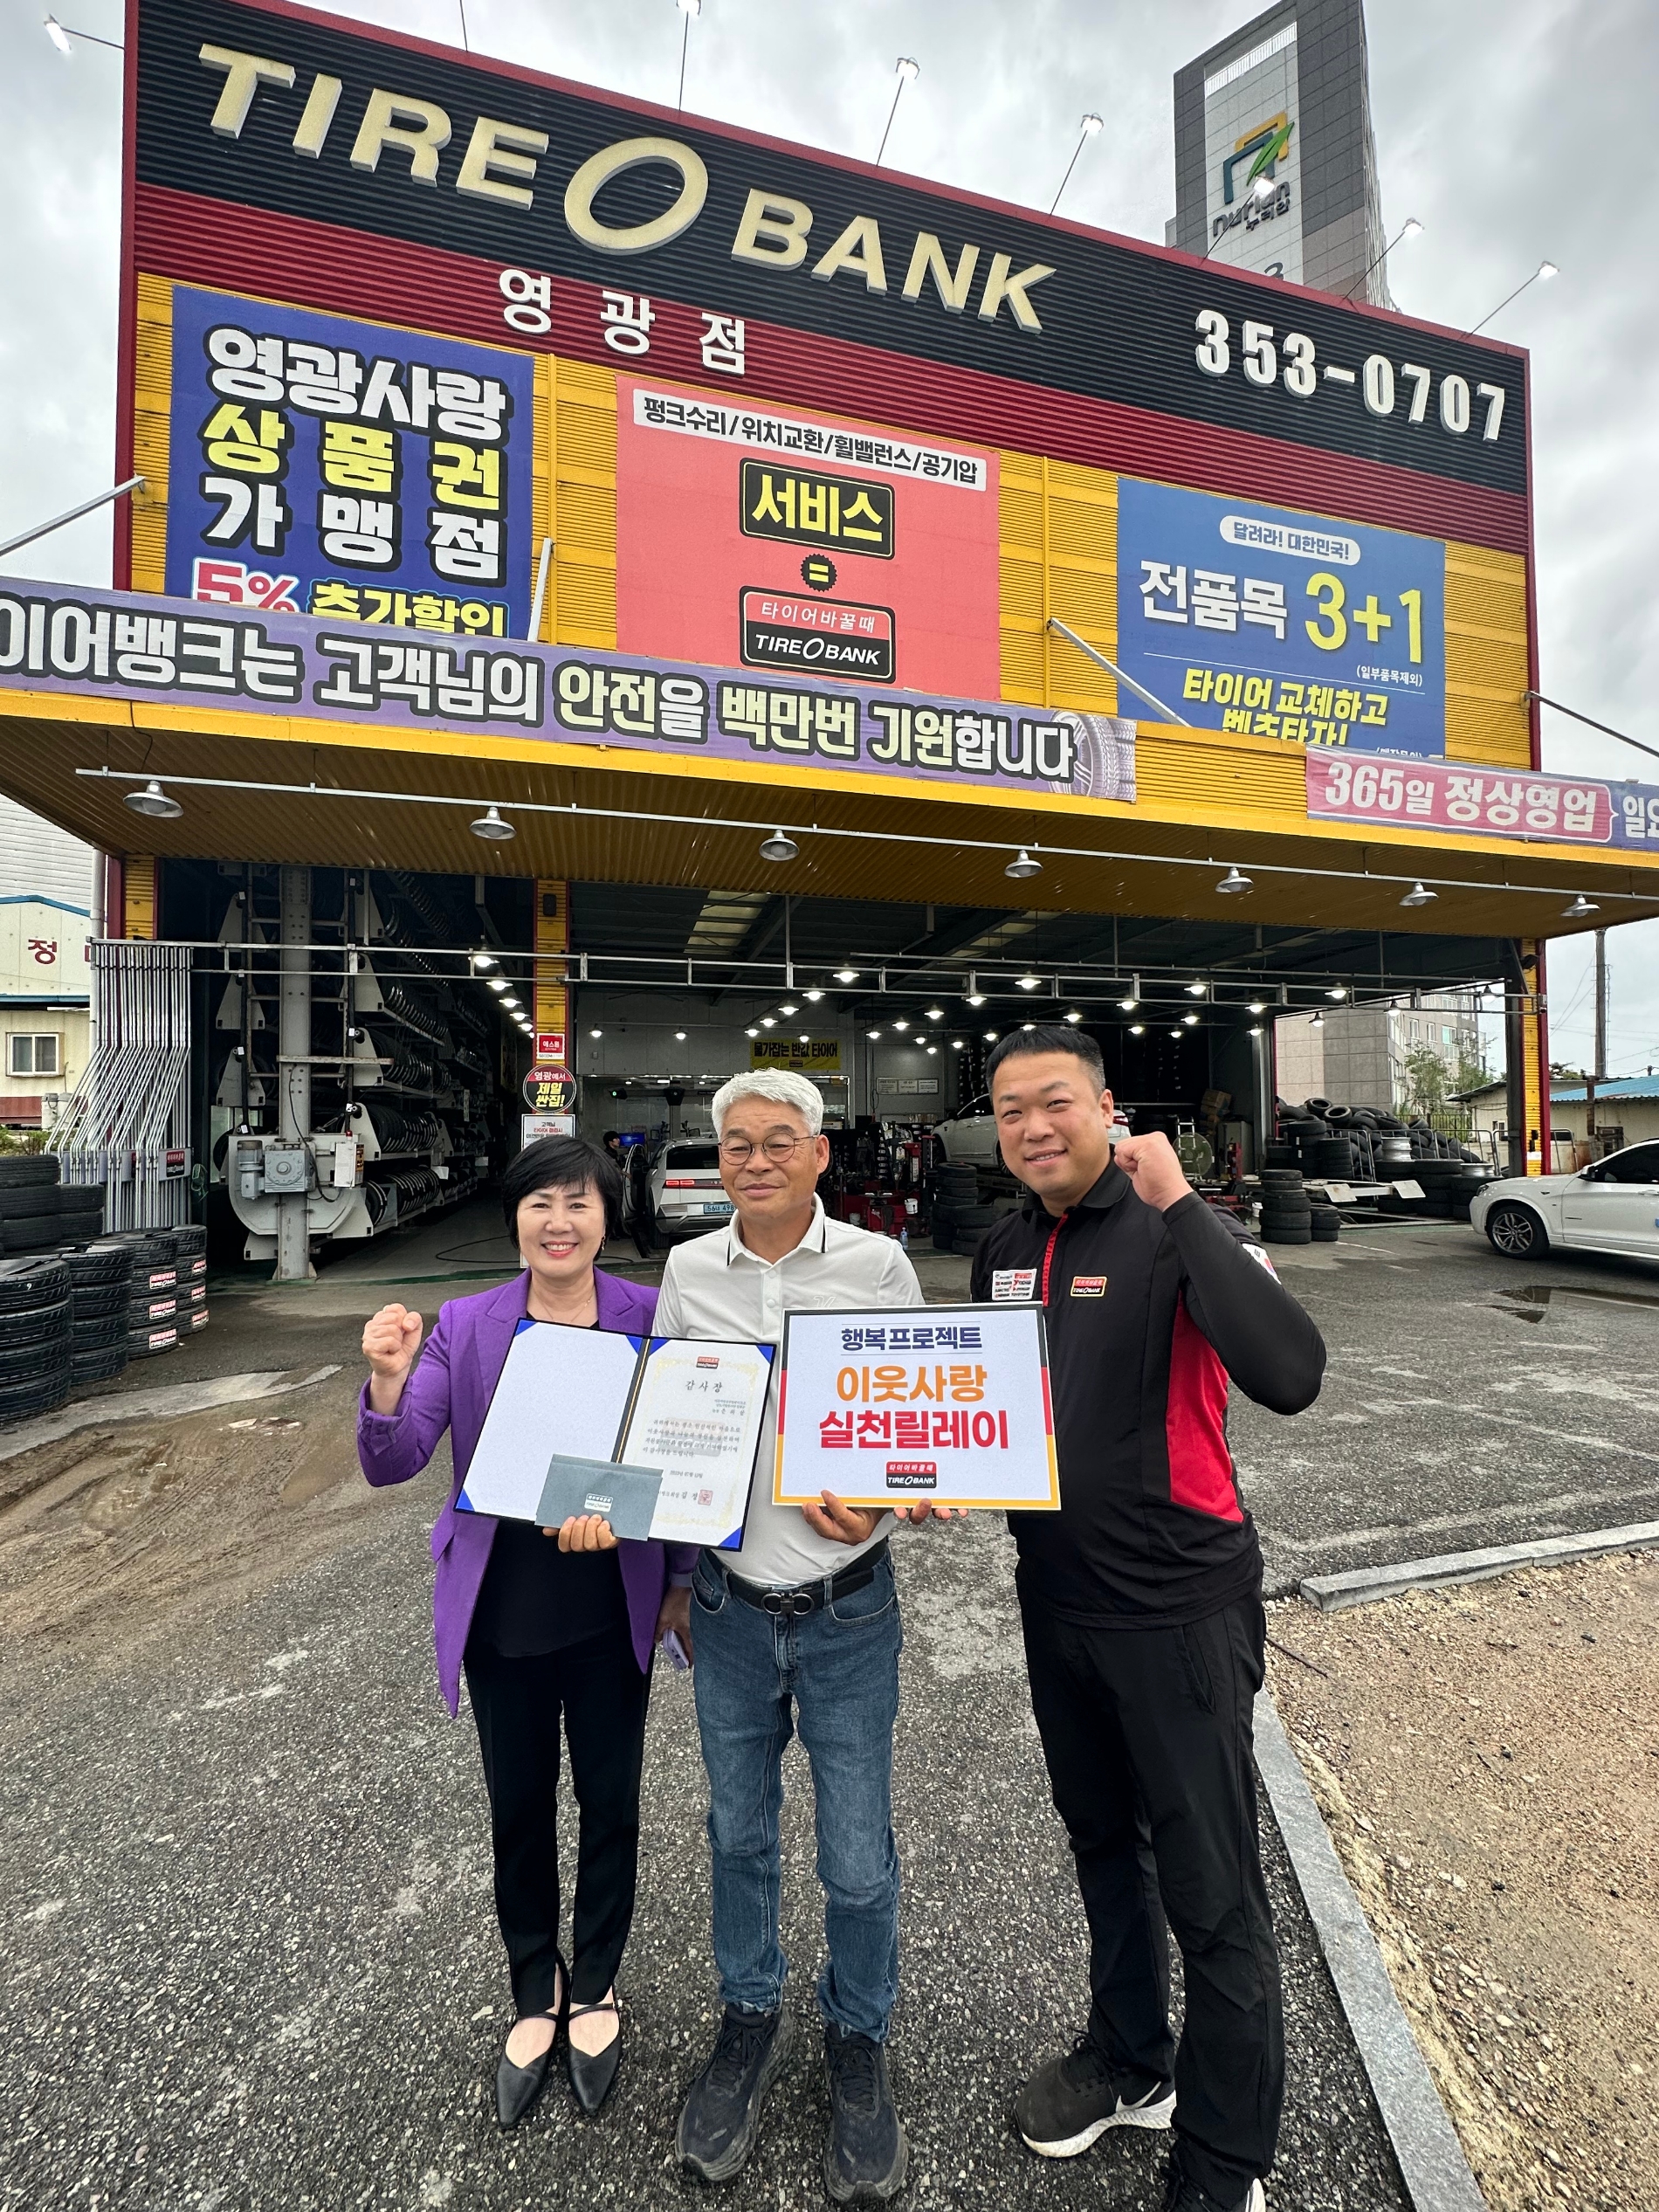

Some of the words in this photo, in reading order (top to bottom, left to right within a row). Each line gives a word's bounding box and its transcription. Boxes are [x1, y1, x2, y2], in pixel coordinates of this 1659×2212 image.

[209, 327, 506, 440] 영광사랑
[1194, 308, 1505, 441] 353-0707
[752, 474, 884, 541] 서비스
[1233, 521, 1283, 548] 달려라!
[1288, 532, 1349, 561] 대한민국!
[196, 562, 296, 612] 5%
[1139, 560, 1288, 640] 전품목
[1304, 572, 1423, 664] 3+1
[1356, 664, 1423, 688] (일부품목제외)
[320, 638, 537, 721] 고객님의
[560, 665, 703, 739] 안전을
[721, 685, 857, 756] 백만번
[873, 706, 1075, 779] 기원합니다
[1183, 668, 1272, 709] 타이어
[1276, 681, 1388, 726] 교체하고
[1325, 762, 1434, 814] 365일
[1445, 775, 1597, 833] 정상영업
[28, 939, 57, 965] 정
[792, 1042, 809, 1058] 반값
[812, 1042, 837, 1058] 타이어
[534, 1072, 566, 1081] 영광에서
[537, 1082, 562, 1094] 제일
[535, 1094, 566, 1107] 싼집!
[841, 1326, 982, 1351] 행복프로젝트
[836, 1365, 988, 1403] 이웃사랑
[819, 1410, 1008, 1450] 실천릴레이
